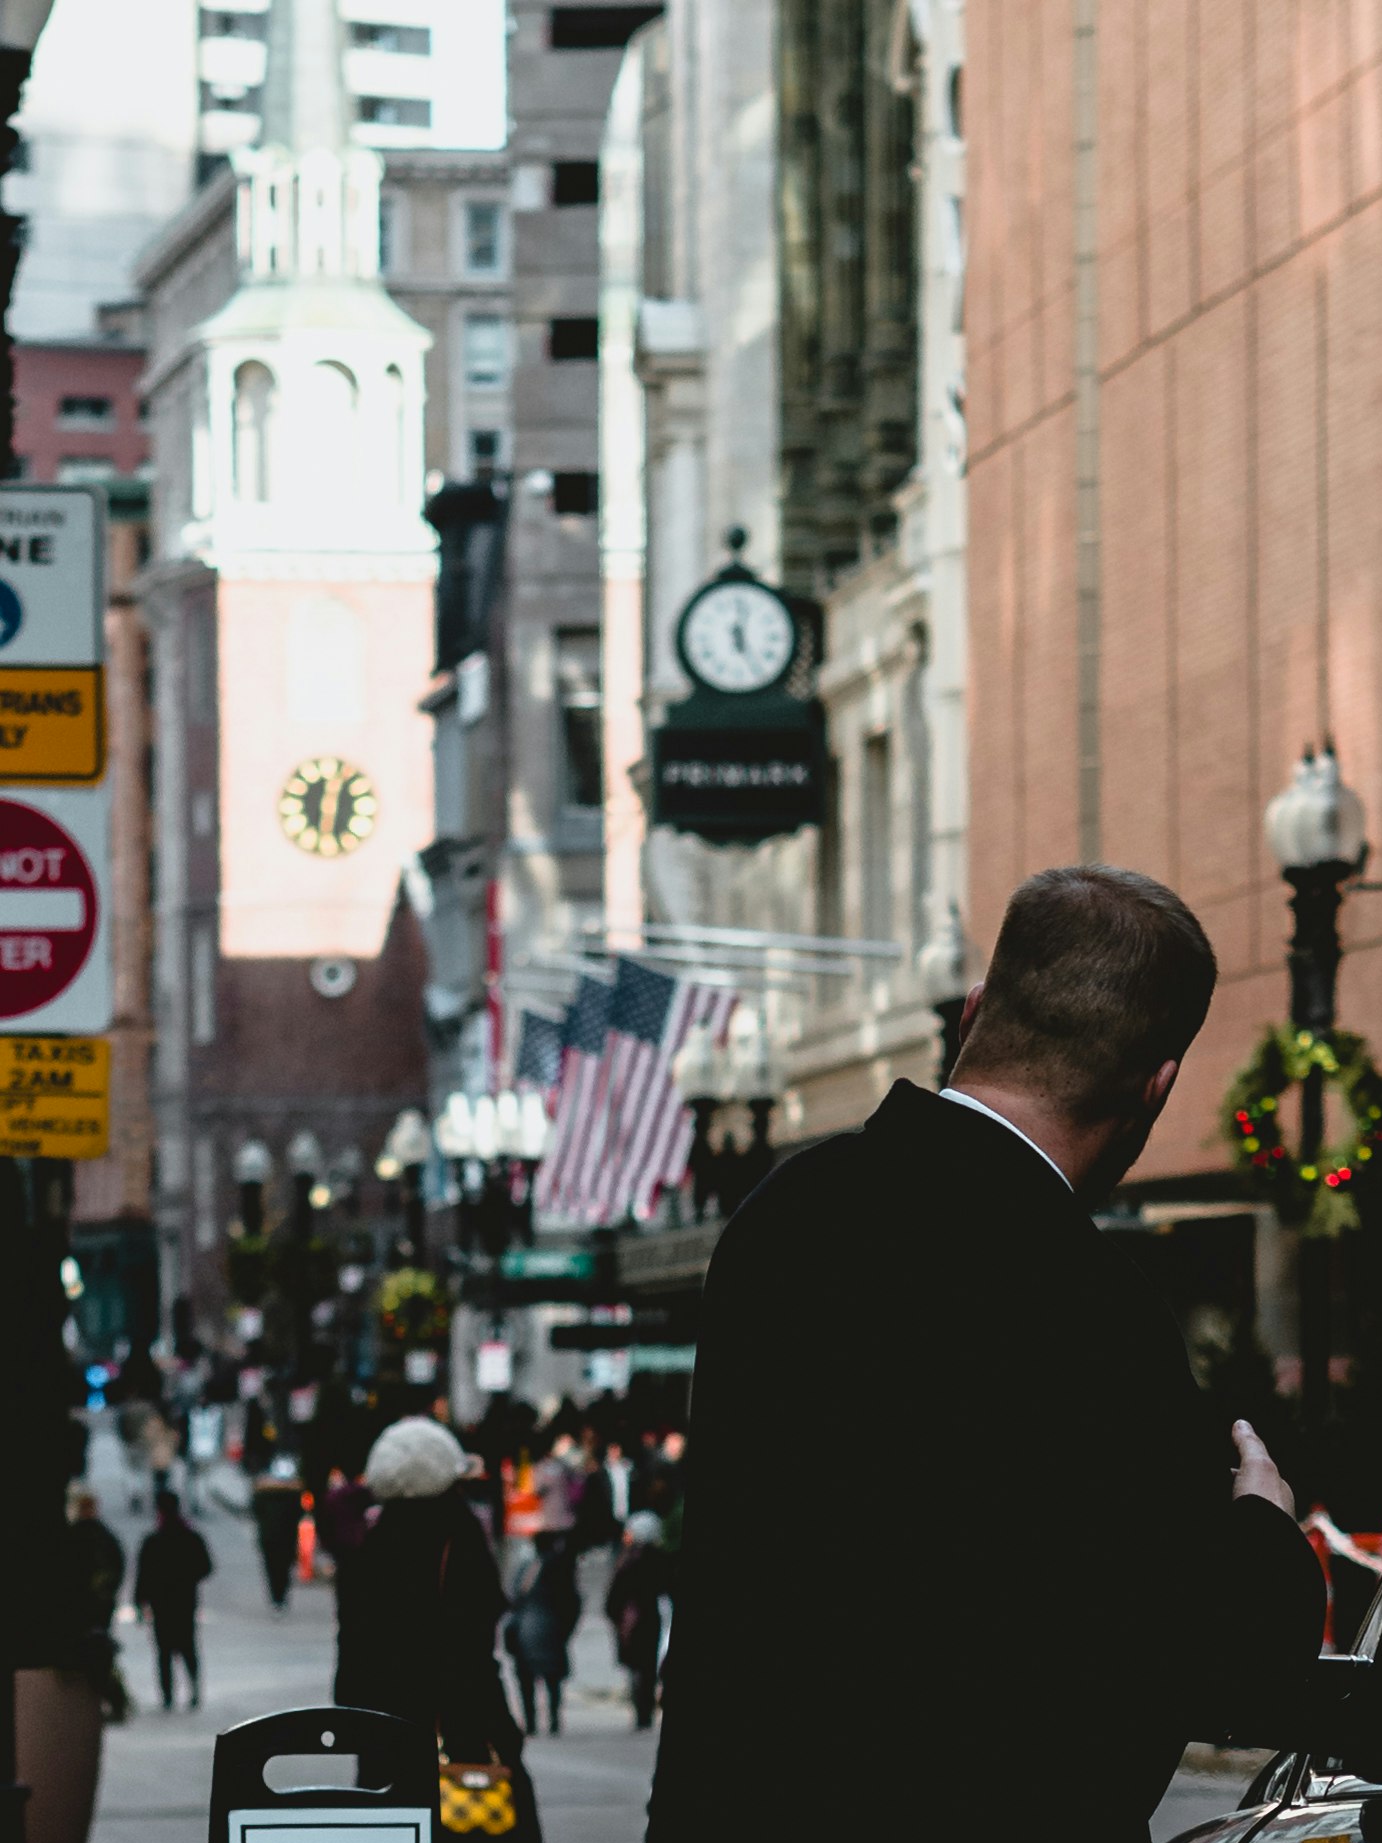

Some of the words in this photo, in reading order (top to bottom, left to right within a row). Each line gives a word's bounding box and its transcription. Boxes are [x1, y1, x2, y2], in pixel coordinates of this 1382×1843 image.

[0, 535, 53, 566] NE
[0, 847, 66, 884] NOT
[0, 935, 53, 972] ER
